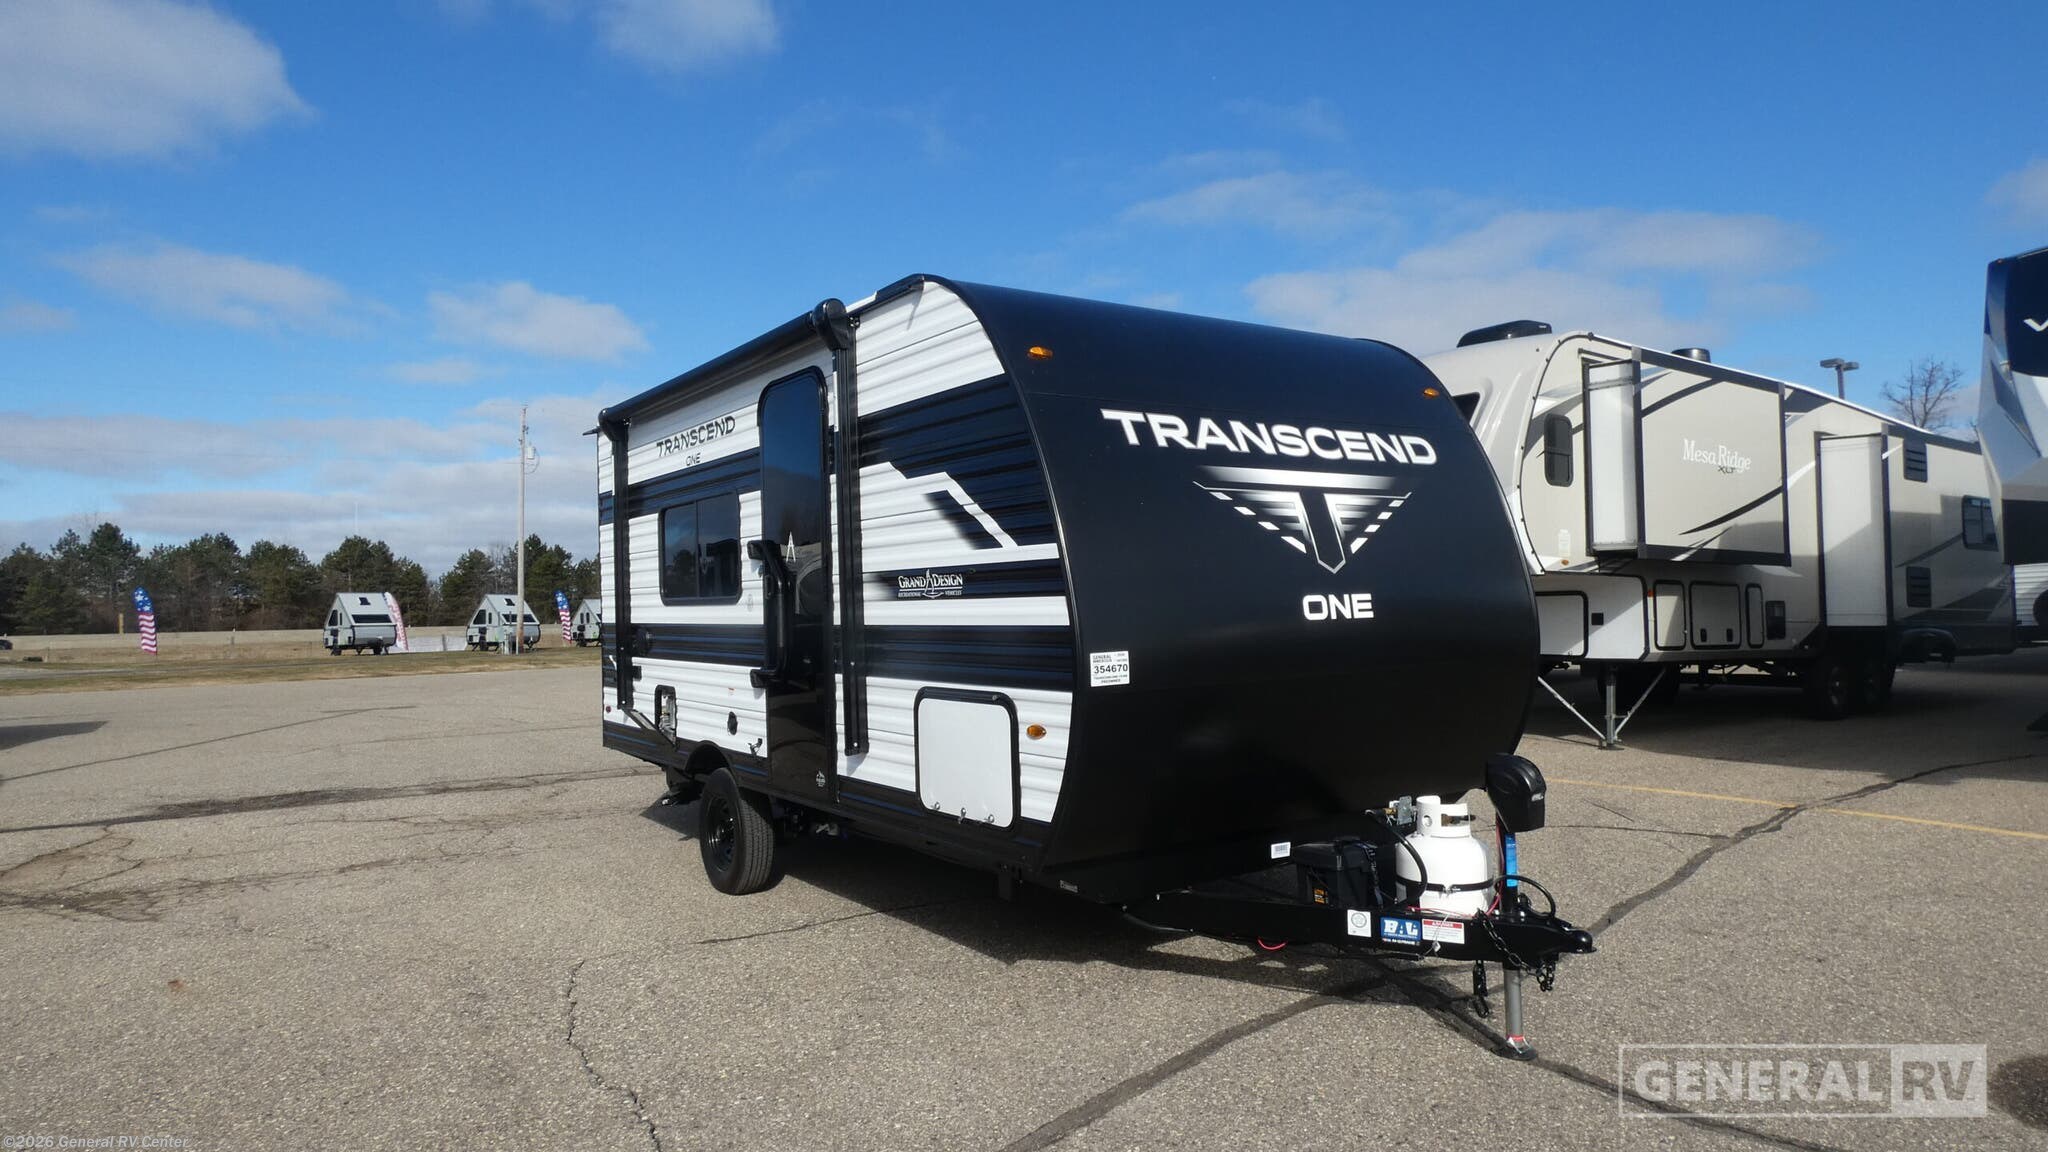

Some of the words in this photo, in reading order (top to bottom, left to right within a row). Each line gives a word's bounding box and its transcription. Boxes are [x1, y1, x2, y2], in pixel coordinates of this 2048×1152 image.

[656, 415, 736, 458] TRANSCEND
[1100, 408, 1437, 465] TRANSCEND
[685, 452, 702, 467] ONE
[1683, 438, 1716, 464] Mesa
[1718, 445, 1752, 474] Ridge
[898, 575, 926, 588] GRAND
[931, 573, 963, 587] DESIGN
[1302, 593, 1374, 621] ONE
[1094, 663, 1129, 674] 354670
